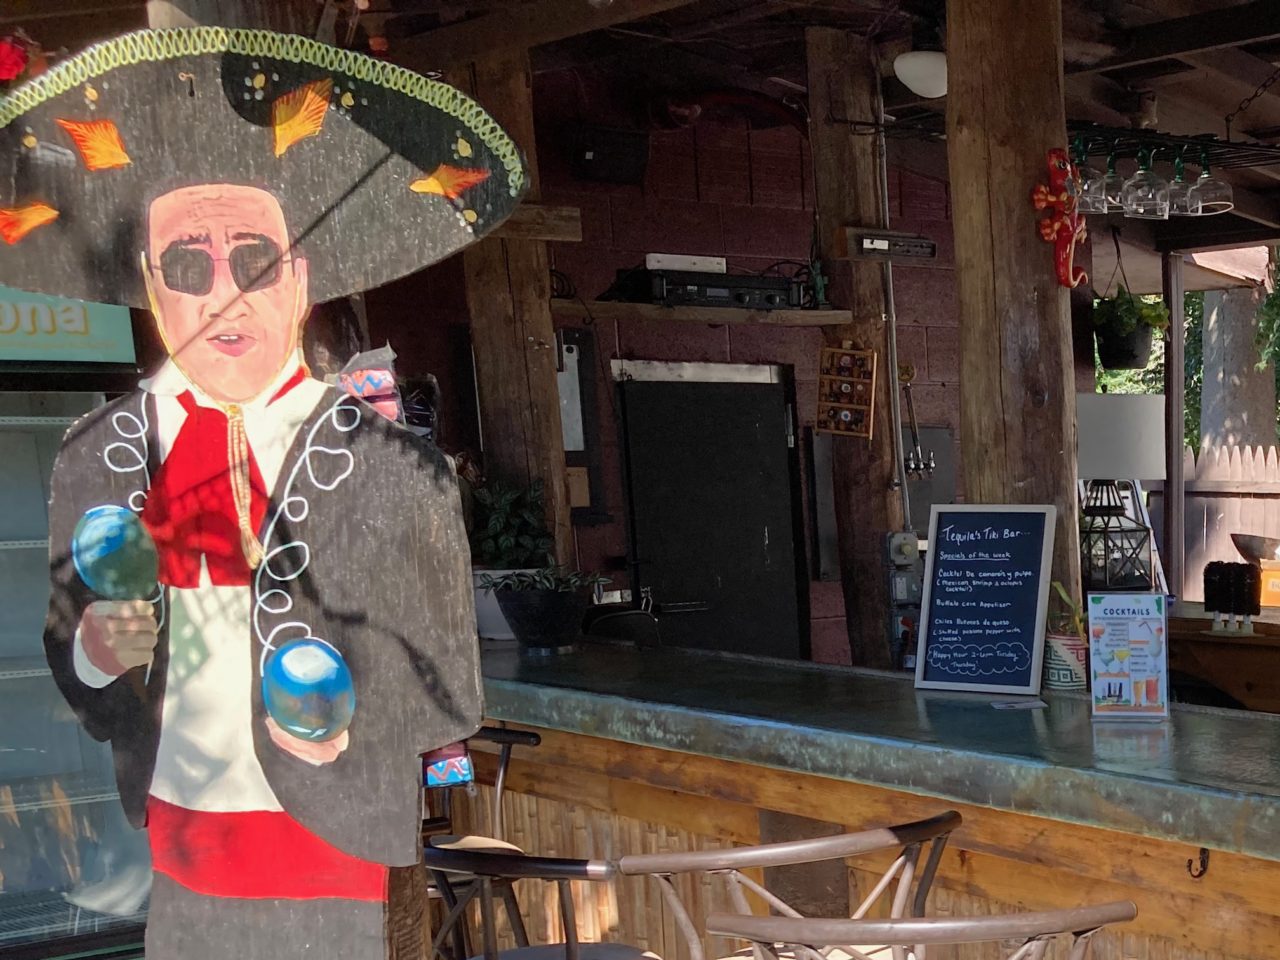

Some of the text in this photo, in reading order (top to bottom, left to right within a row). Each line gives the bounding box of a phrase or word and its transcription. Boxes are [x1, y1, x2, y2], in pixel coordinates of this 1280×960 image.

[942, 525, 981, 546] Tequila's
[982, 526, 999, 540] Tiki
[940, 551, 1011, 561] Specials of the week
[965, 570, 975, 578] De
[1103, 608, 1151, 616] COCKTAILS
[982, 618, 991, 626] de
[932, 649, 951, 660] Happy
